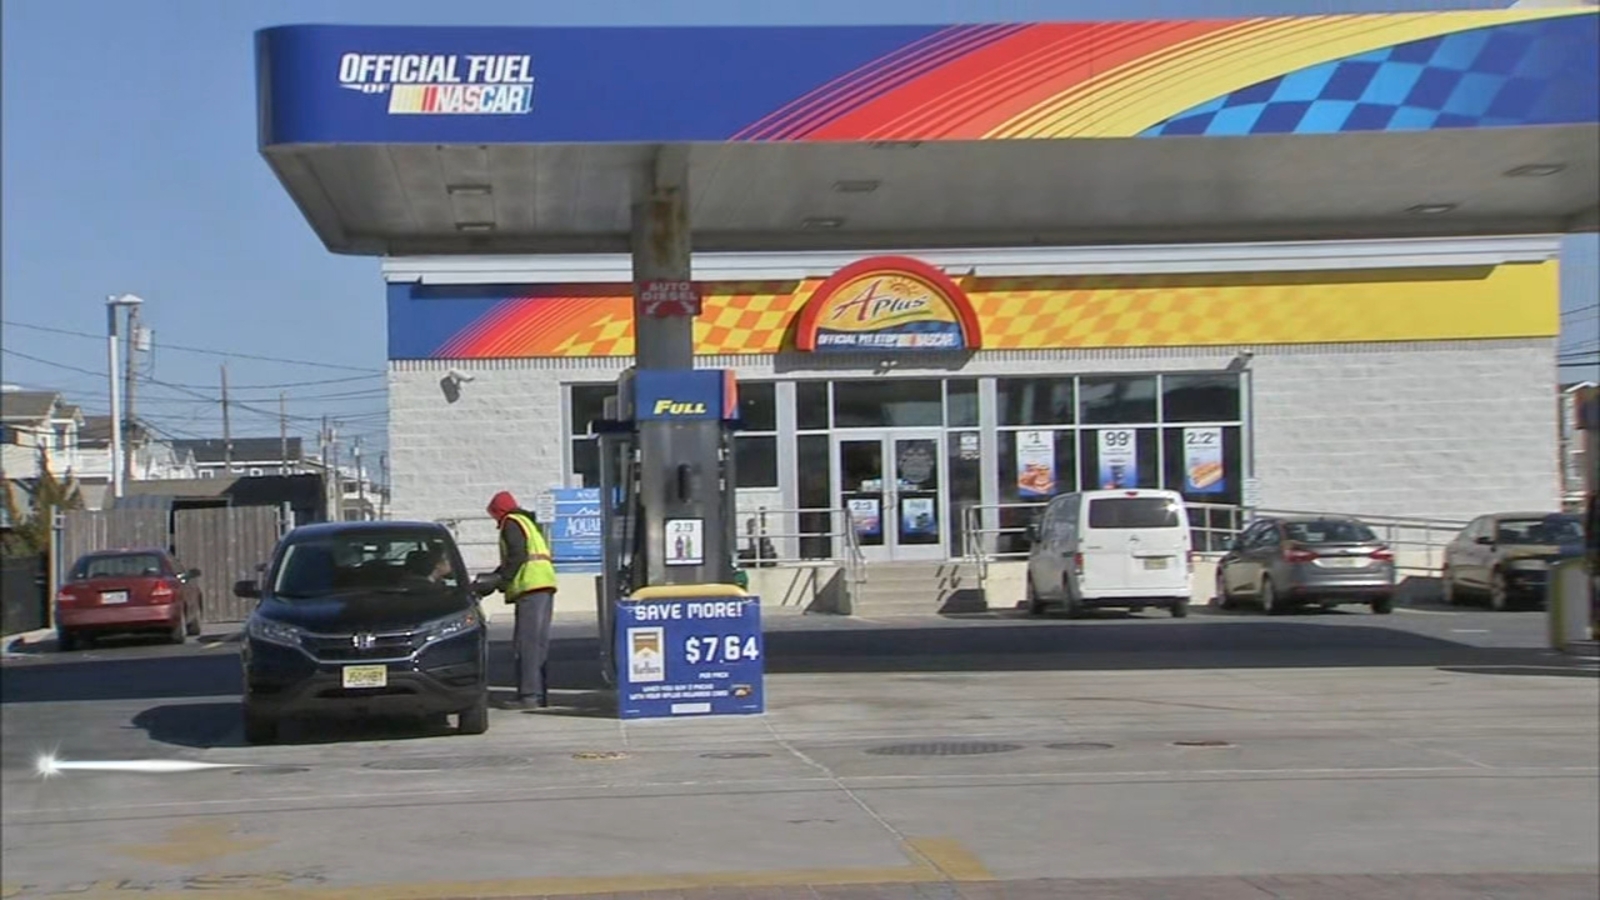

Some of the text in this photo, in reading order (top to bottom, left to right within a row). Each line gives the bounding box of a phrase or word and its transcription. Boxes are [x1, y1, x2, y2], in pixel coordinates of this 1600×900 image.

[339, 53, 535, 83] OFFICIAL FUEL
[362, 84, 526, 110] OF NASCAR
[649, 282, 690, 291] AUTO
[641, 292, 698, 301] DIESEL
[817, 333, 856, 345] OFFICIAL
[635, 602, 742, 620] SAVE MORE!
[685, 635, 759, 664] $7.64
